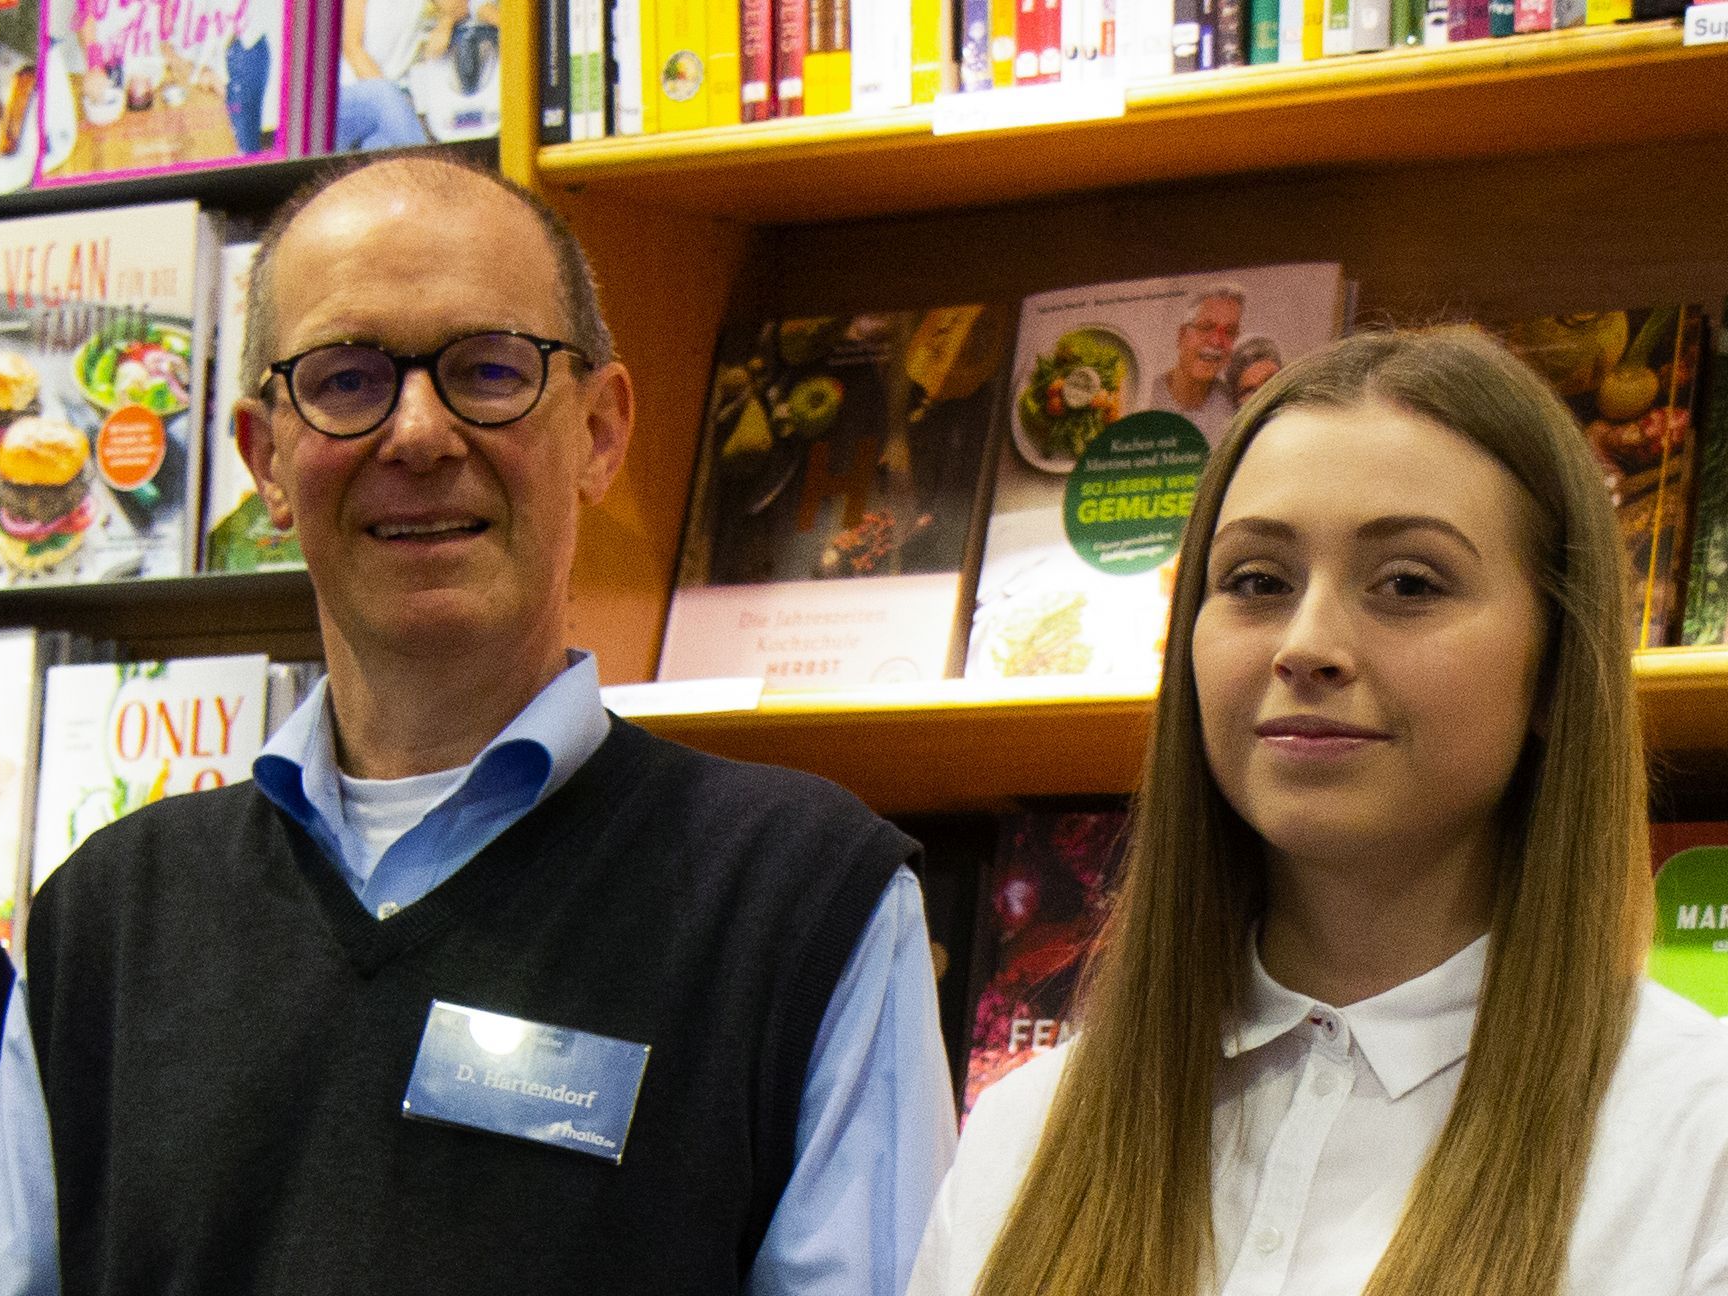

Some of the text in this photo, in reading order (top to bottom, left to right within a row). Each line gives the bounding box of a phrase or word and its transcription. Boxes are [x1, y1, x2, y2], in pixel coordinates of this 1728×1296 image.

[5, 238, 112, 311] VEGAN
[116, 695, 246, 763] ONLY
[455, 1063, 477, 1084] D.
